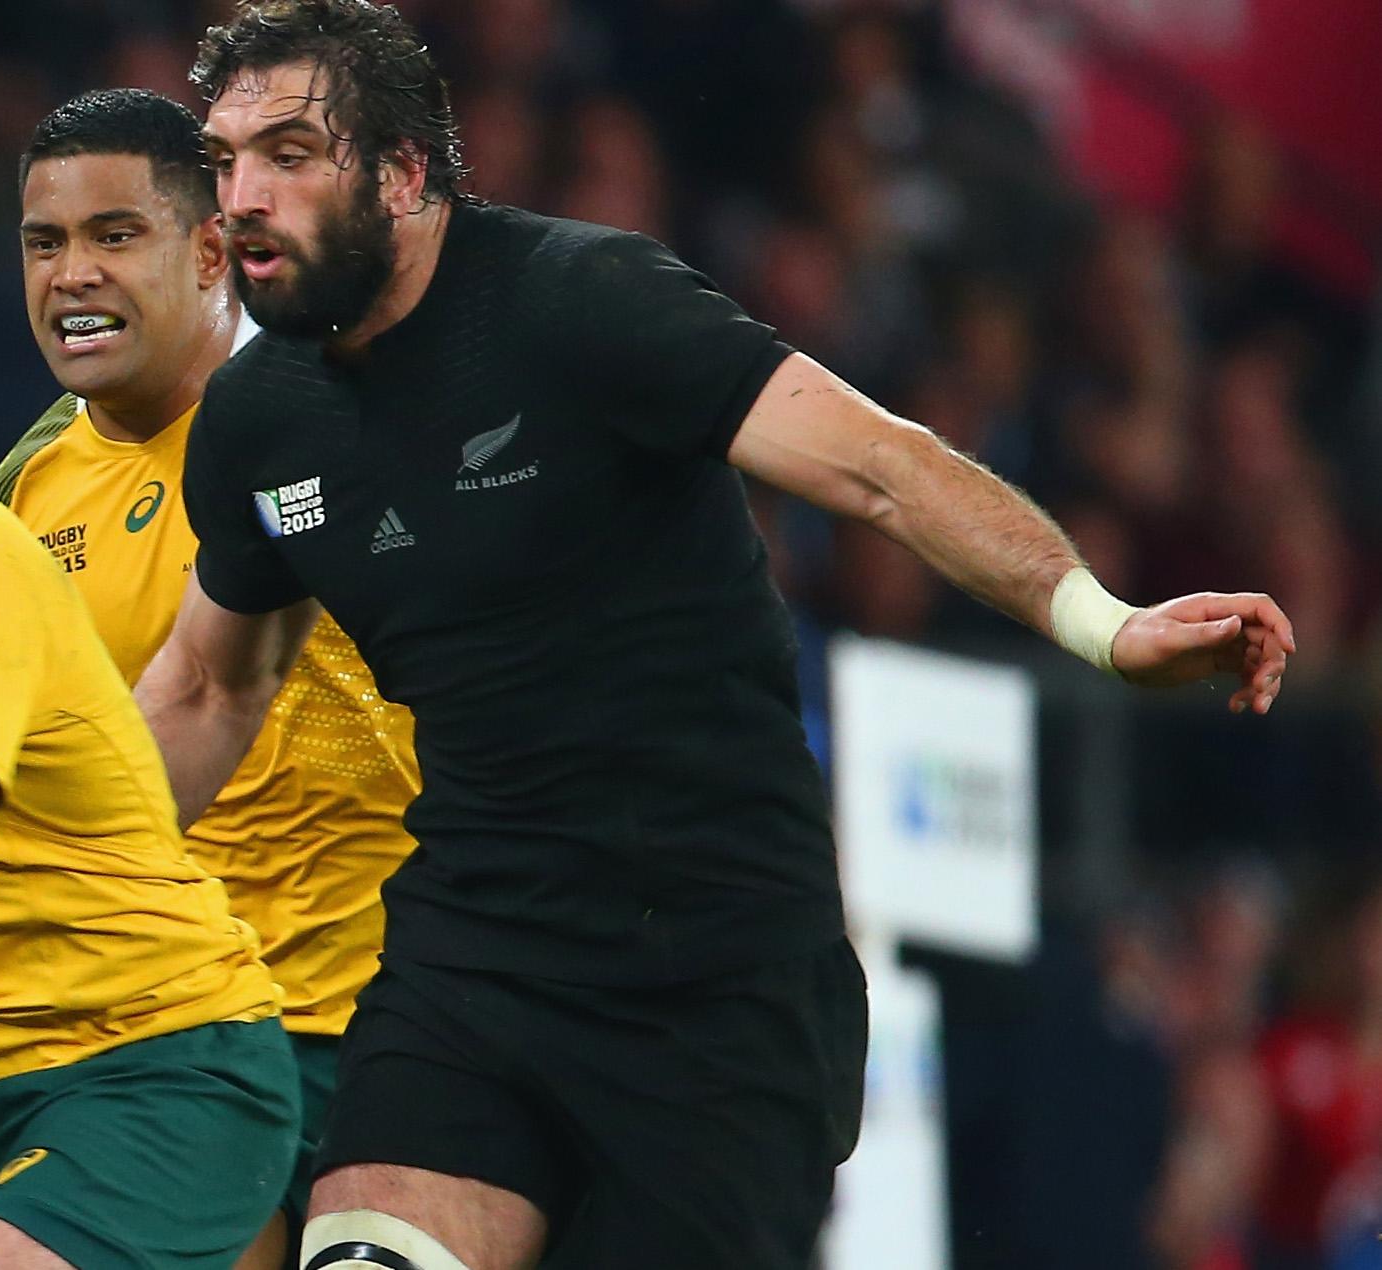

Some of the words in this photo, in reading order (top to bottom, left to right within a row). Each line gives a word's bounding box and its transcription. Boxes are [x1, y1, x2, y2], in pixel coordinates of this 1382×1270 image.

[278, 476, 321, 504] RUGBY
[455, 479, 479, 491] ALL
[481, 465, 538, 488] BLACKS
[281, 507, 326, 535] 2015
[64, 553, 86, 572] 15
